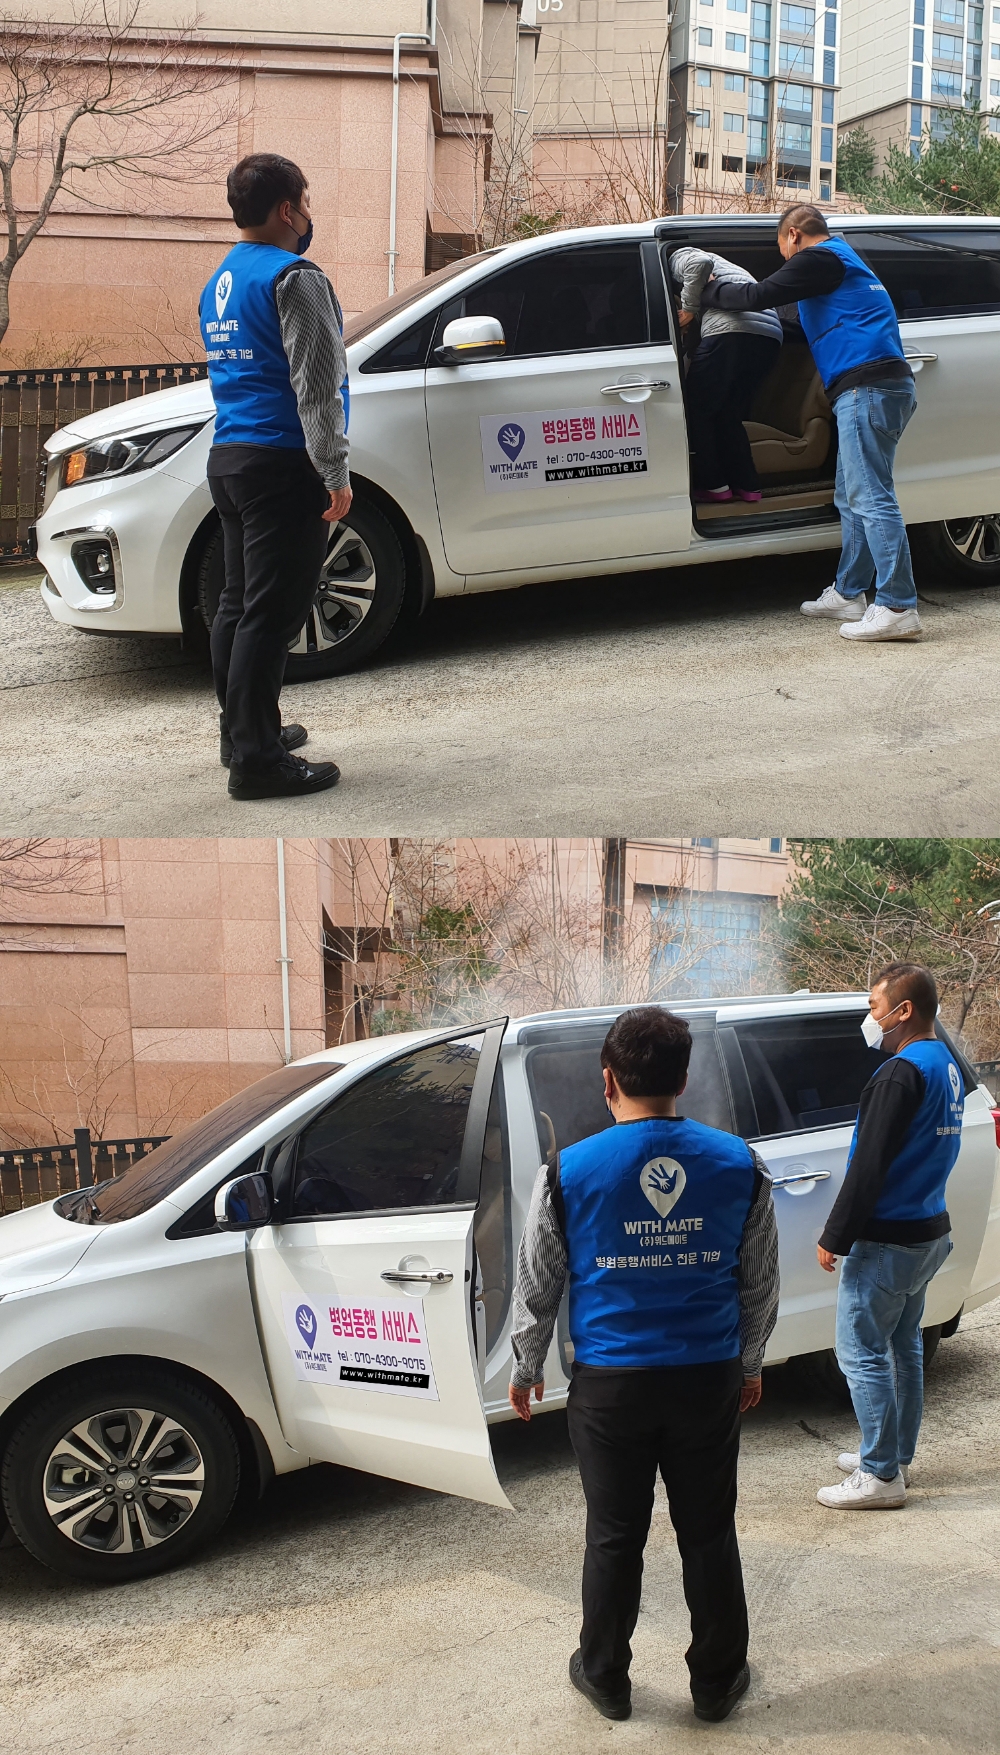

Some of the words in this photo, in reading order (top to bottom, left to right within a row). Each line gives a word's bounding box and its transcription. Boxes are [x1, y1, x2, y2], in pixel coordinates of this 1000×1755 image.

[220, 319, 239, 331] MATE
[238, 349, 254, 360] 기업
[542, 416, 596, 445] 병원동행
[601, 413, 641, 439] 서비스
[546, 454, 559, 465] tel
[566, 447, 643, 463] 070-4300-9075
[490, 463, 513, 474] WITH
[514, 460, 538, 471] MATE
[547, 461, 645, 481] www.withmate.kr
[624, 1220, 662, 1235] WITH
[665, 1218, 703, 1233] MATE
[640, 1234, 688, 1247] (주)위드메이트
[595, 1254, 673, 1269] 병원동행서비스
[676, 1252, 698, 1266] 전문
[701, 1250, 721, 1263] 기업
[329, 1307, 378, 1340] 병원동행
[381, 1310, 421, 1344] 서비스
[294, 1349, 313, 1361] WITH
[313, 1352, 333, 1363] MATE
[337, 1350, 348, 1362] tel
[354, 1351, 426, 1371] 070-4300-9075
[341, 1368, 423, 1384] www.withmate.kr
